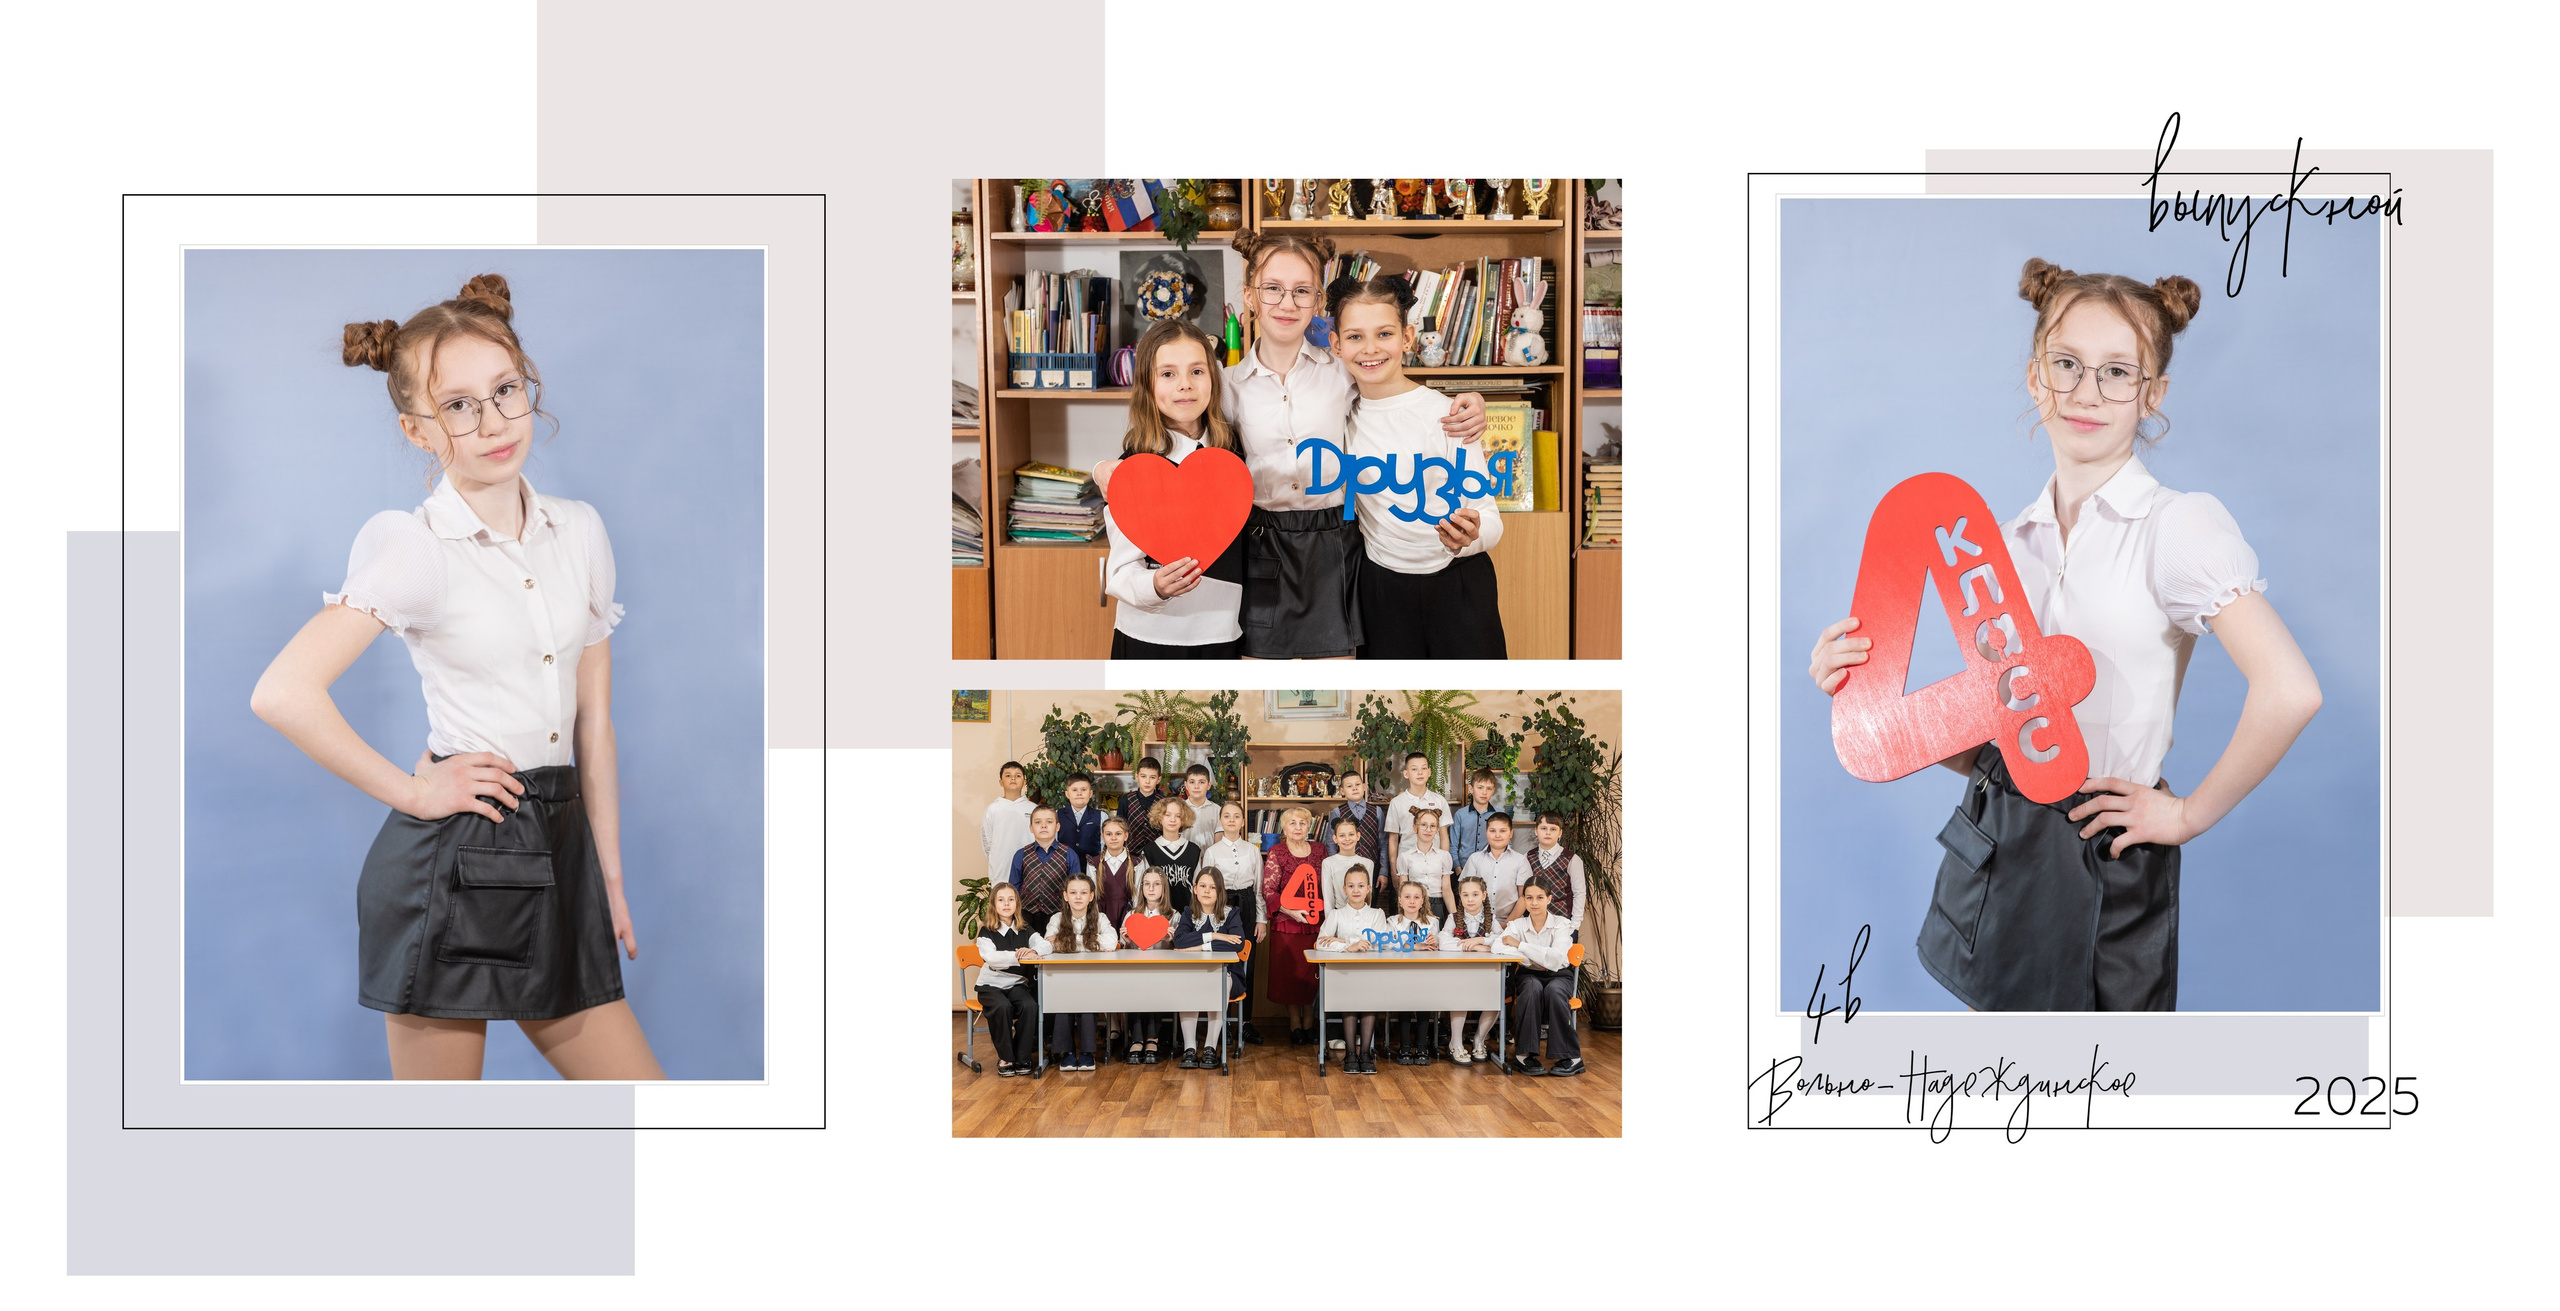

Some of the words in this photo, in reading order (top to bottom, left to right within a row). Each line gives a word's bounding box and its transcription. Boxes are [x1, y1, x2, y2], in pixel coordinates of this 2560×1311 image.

[1296, 438, 1517, 526] Друзья
[1832, 472, 2096, 804] 4
[1934, 516, 2061, 764] класс
[1280, 863, 1325, 925] 4
[1306, 872, 1316, 919] класс
